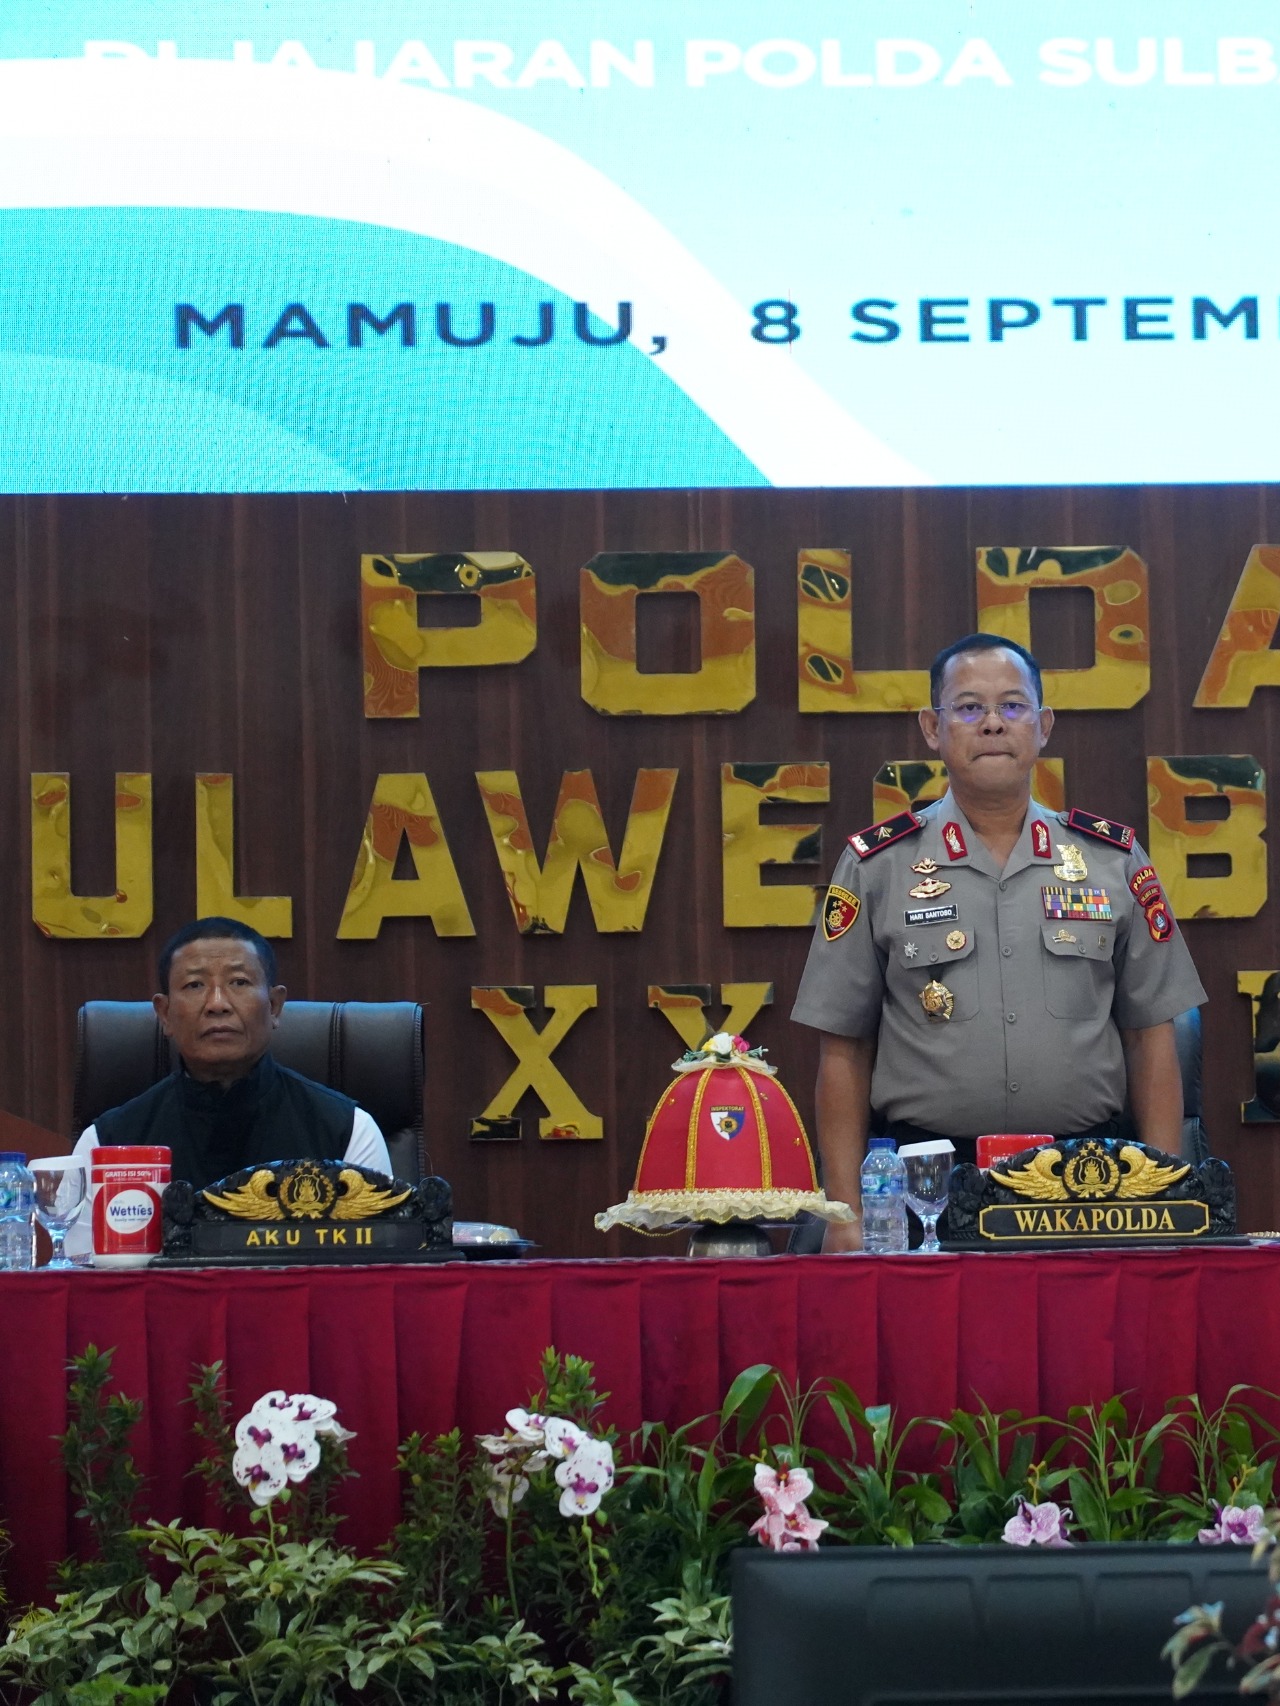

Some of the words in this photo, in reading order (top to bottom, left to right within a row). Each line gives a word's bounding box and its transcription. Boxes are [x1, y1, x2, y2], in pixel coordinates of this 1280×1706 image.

[686, 38, 1013, 89] POLDA
[175, 302, 667, 355] MAMUJU,
[751, 300, 801, 344] 8
[1134, 868, 1154, 890] POLDA
[909, 913, 924, 921] HARI
[925, 909, 952, 919] SANTOSO
[1014, 1207, 1176, 1233] WAKAPOLDA
[246, 1229, 300, 1246] AKU
[315, 1228, 347, 1245] TK
